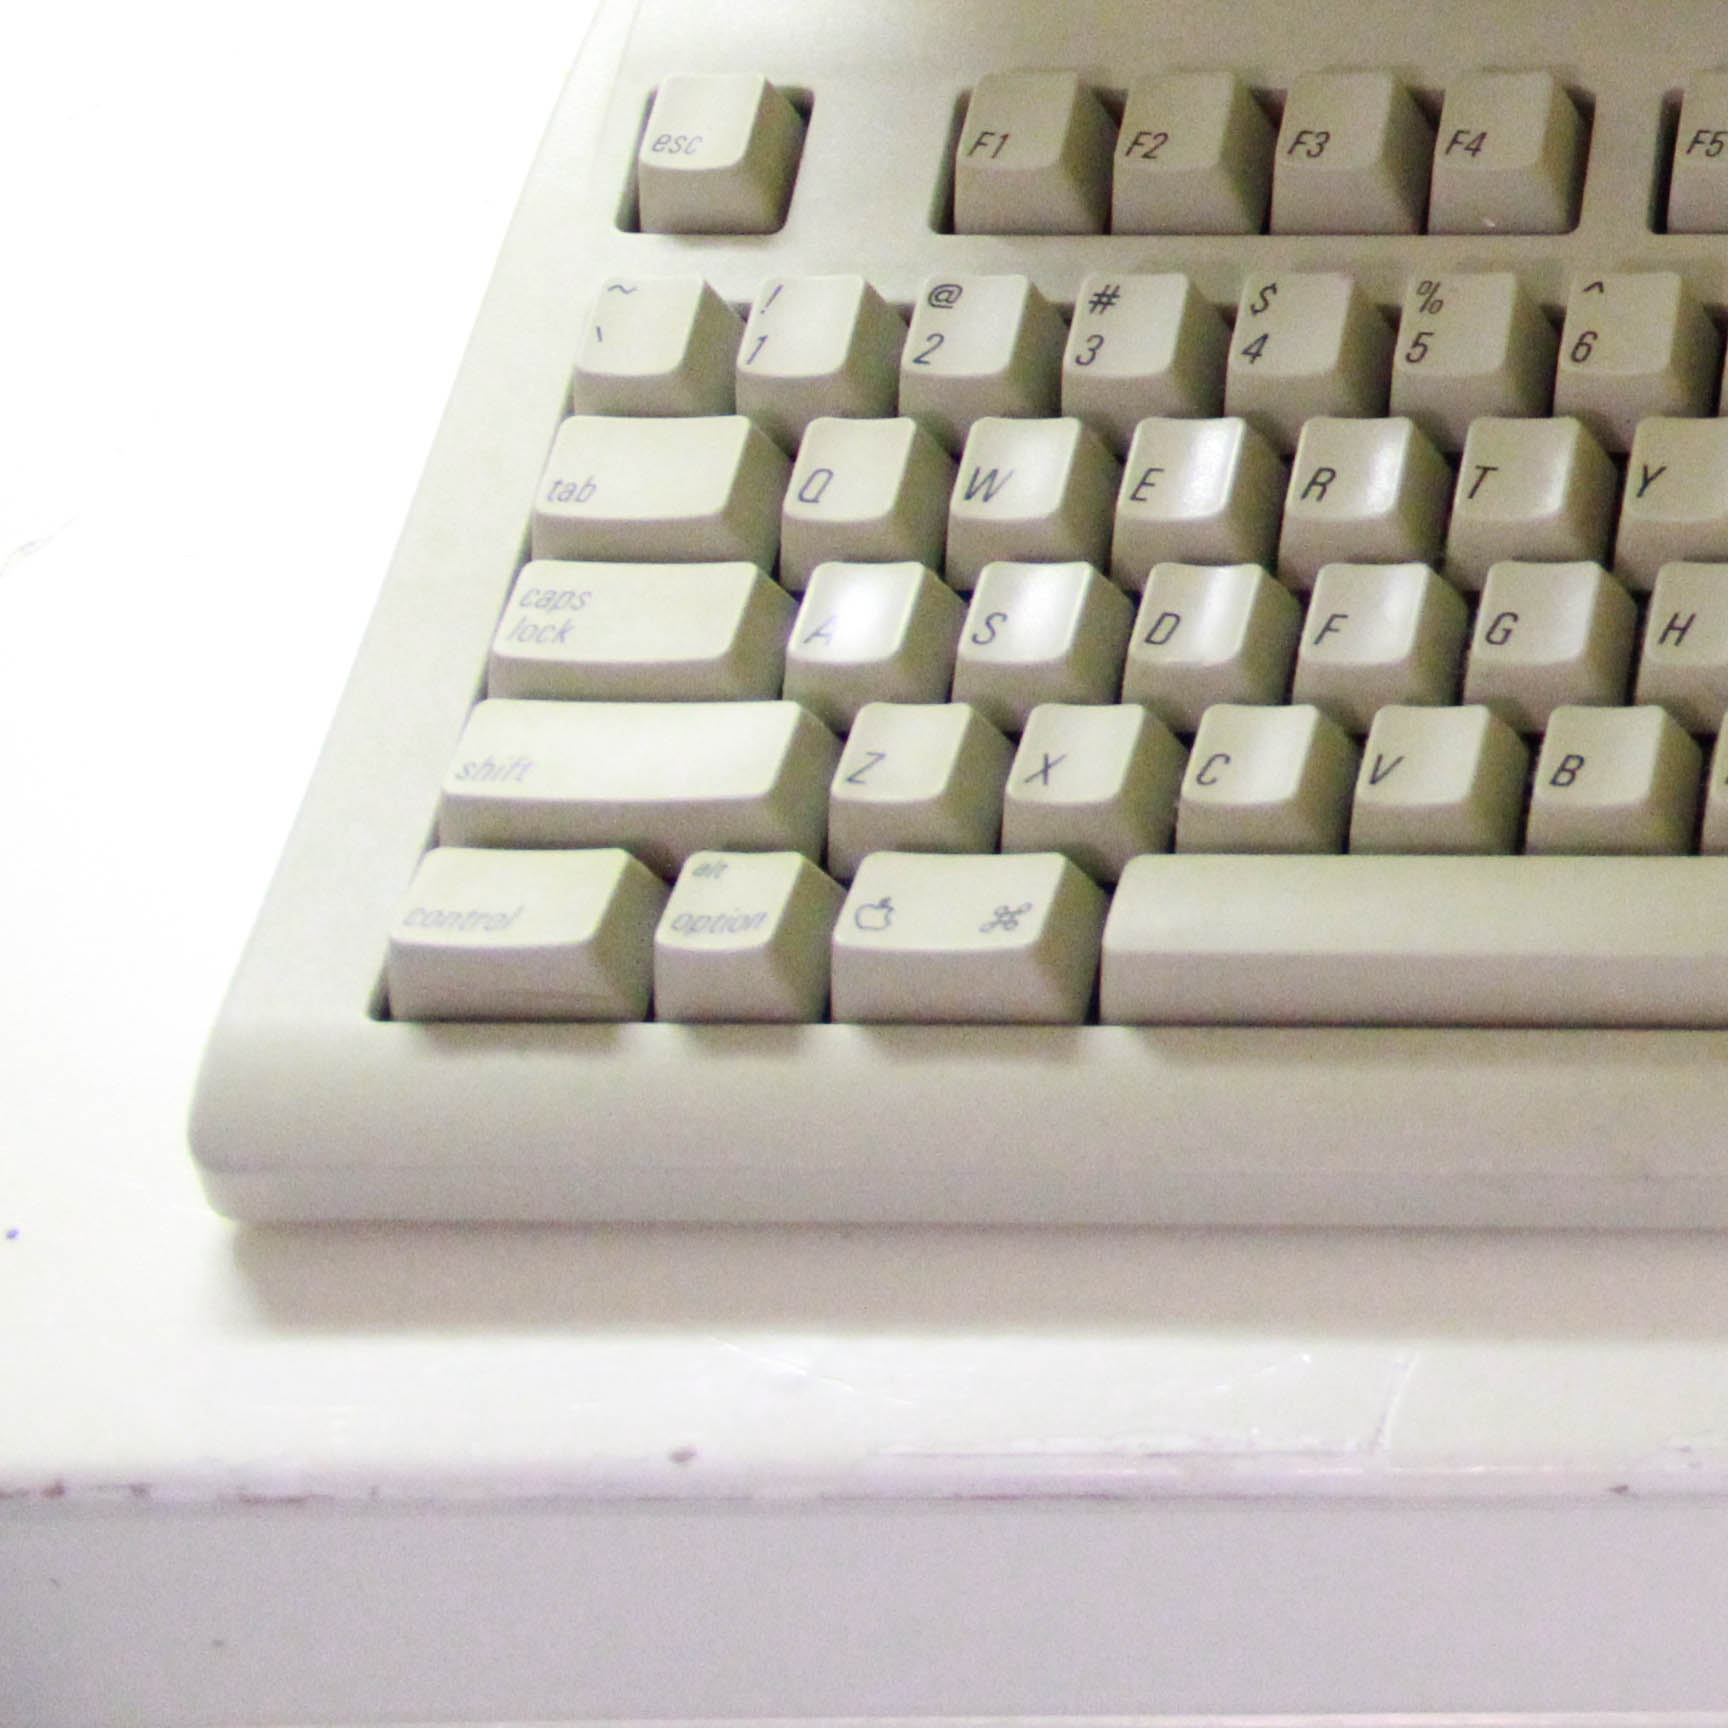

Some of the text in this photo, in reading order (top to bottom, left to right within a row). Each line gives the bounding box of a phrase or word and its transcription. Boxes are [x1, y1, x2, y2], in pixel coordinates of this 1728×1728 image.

[652, 134, 702, 155] esc
[967, 132, 1011, 158] F1
[1126, 133, 1169, 159] F2
[1287, 131, 1331, 158] F3
[1445, 131, 1488, 158] F4
[1686, 131, 1728, 158] F5
[761, 286, 782, 315] !
[928, 283, 963, 309] @
[1089, 285, 1121, 314] #
[1250, 284, 1278, 316] $
[1416, 282, 1443, 314] %
[747, 336, 768, 366] 1
[913, 333, 945, 366] 2
[1075, 334, 1104, 366] 3
[1242, 333, 1268, 363] 4
[1405, 333, 1433, 363] 5
[1571, 331, 1597, 363] 6
[548, 477, 596, 503] tab
[799, 468, 833, 504] Q
[963, 470, 1013, 502] W
[1130, 468, 1166, 501] E
[1300, 467, 1336, 501] R
[1467, 466, 1497, 500] T
[1635, 466, 1666, 499] Y
[519, 587, 593, 611] caps
[506, 617, 575, 645] lock
[803, 612, 834, 646] A
[972, 611, 1007, 646] S
[1145, 612, 1183, 646] D
[1315, 613, 1347, 646] F
[1486, 612, 1518, 646] G
[1658, 613, 1696, 646] H
[455, 757, 531, 782] shift
[846, 750, 885, 784] Z
[1024, 753, 1064, 786] X
[1196, 753, 1231, 786] C
[1368, 754, 1402, 786] V
[1550, 753, 1586, 787] B
[403, 907, 520, 930] control
[670, 908, 767, 936] option
